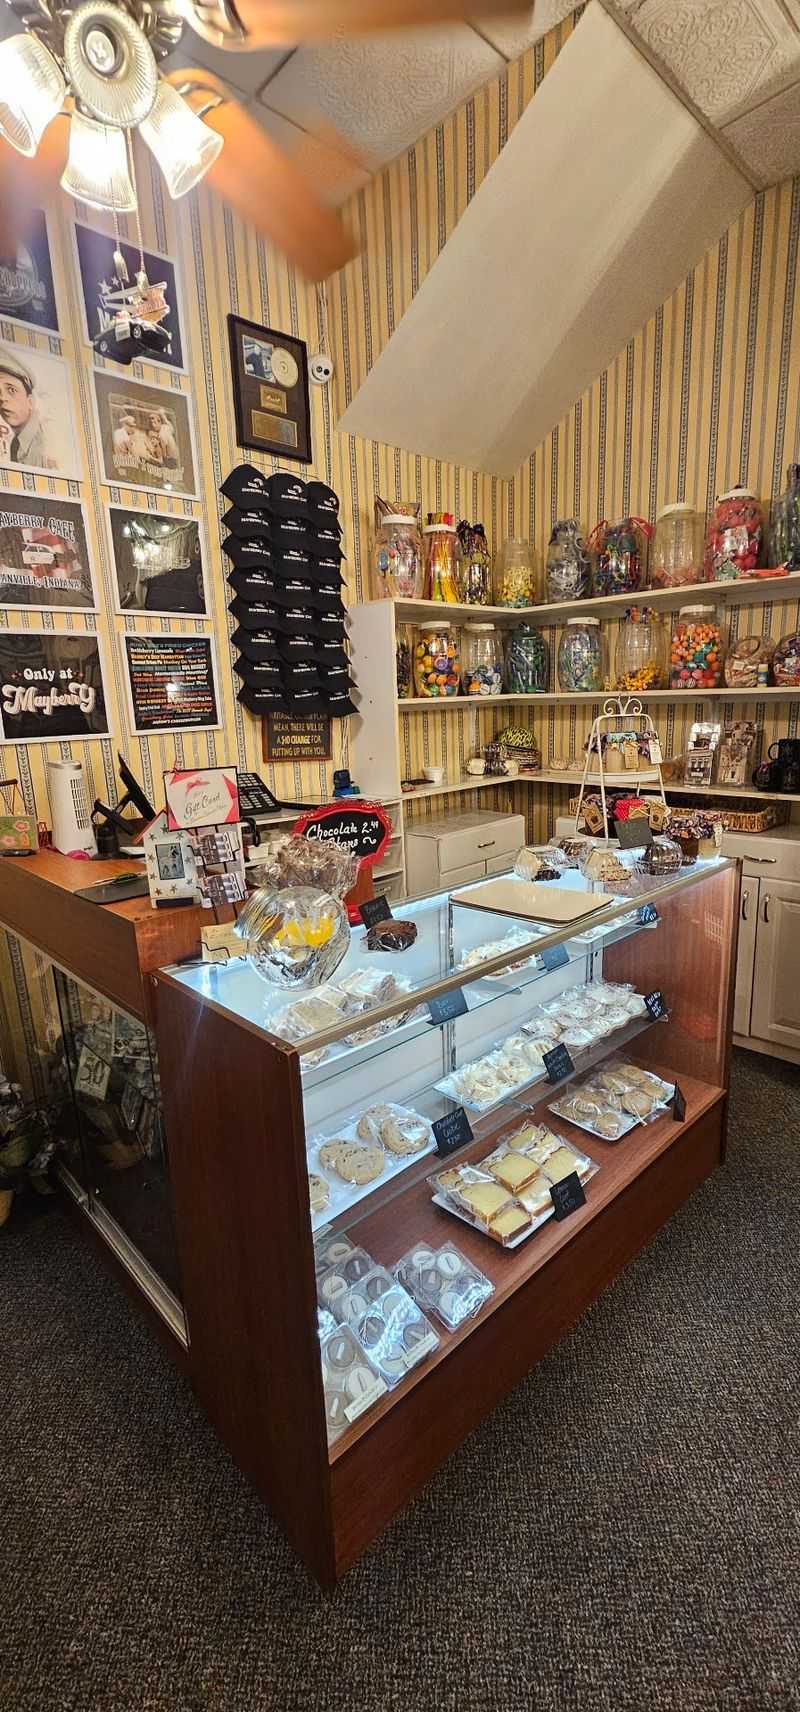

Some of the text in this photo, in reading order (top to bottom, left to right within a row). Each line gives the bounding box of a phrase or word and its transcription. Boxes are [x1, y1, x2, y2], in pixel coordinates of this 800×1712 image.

[0, 511, 44, 528] AYBERRY
[0, 574, 41, 587] ANVILLE,
[23, 667, 73, 681] Only at
[306, 822, 358, 841] Chocolate
